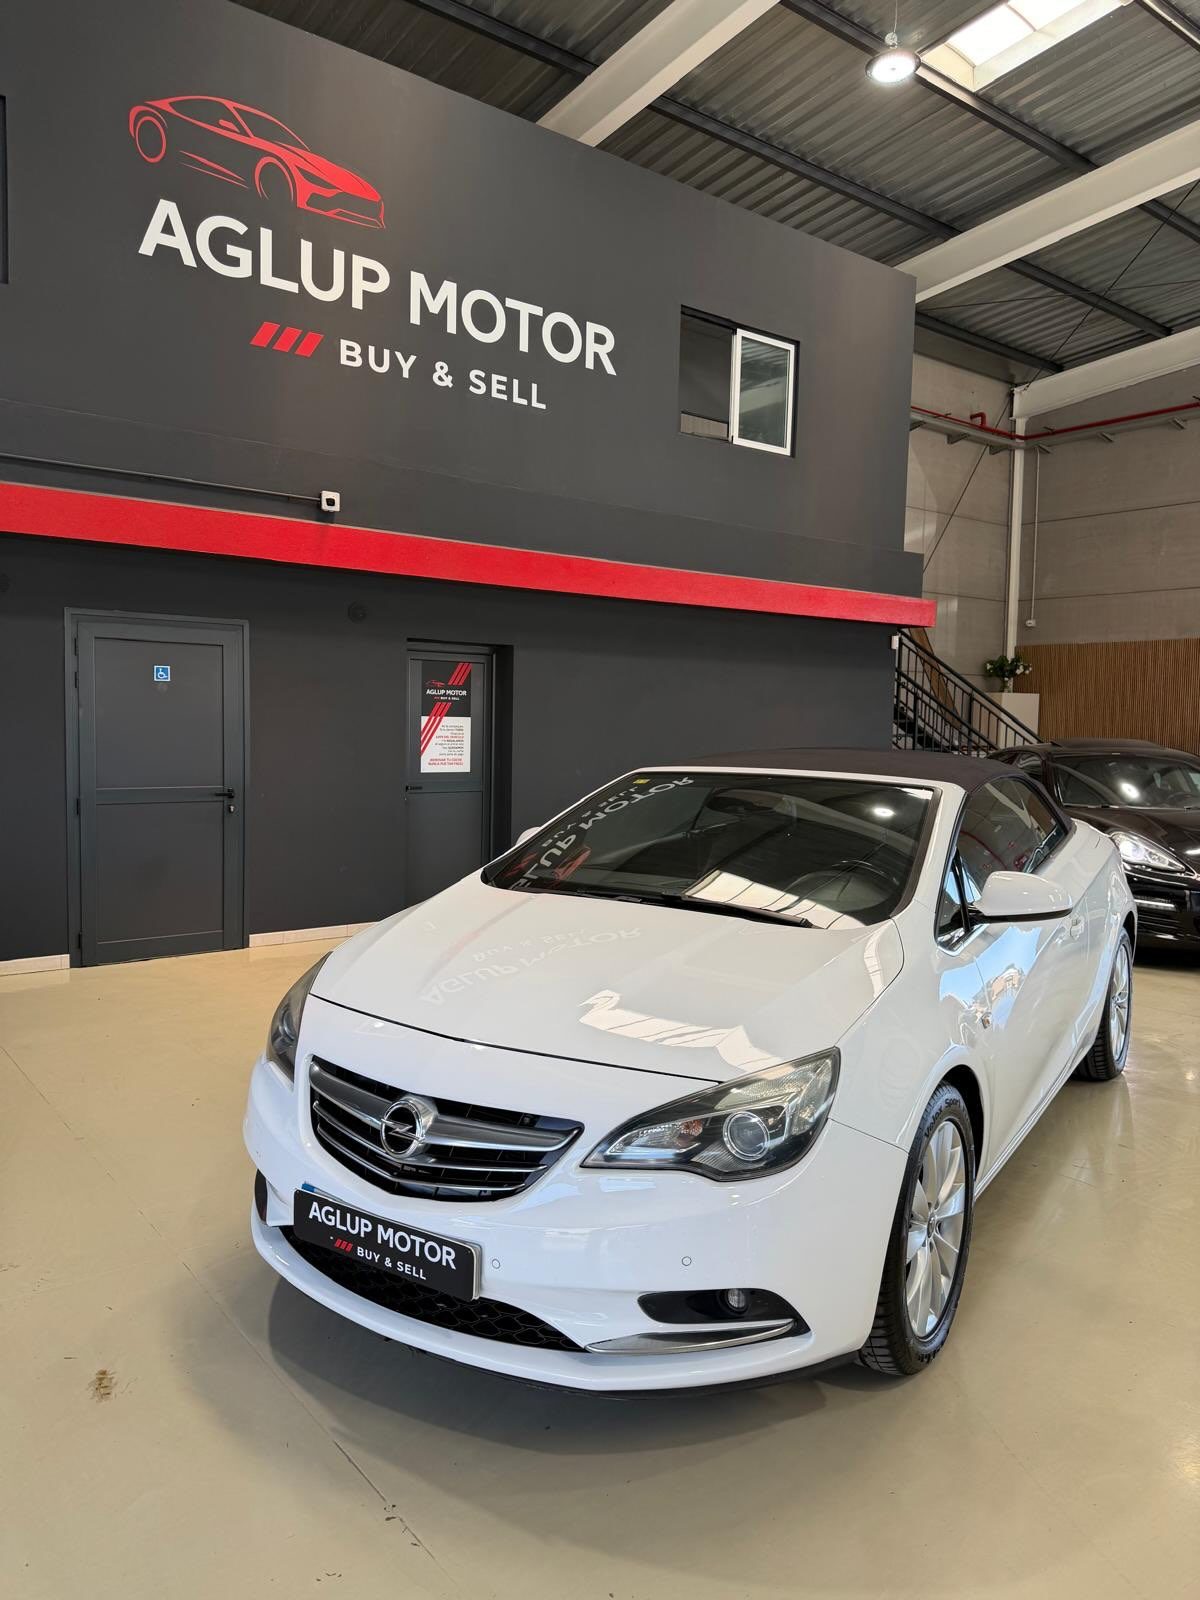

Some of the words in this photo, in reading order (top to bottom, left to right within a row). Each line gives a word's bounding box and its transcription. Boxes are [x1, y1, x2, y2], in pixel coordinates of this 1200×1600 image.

[138, 198, 391, 310] AGLUP
[409, 270, 617, 376] MOTOR
[339, 338, 418, 379] BUY
[432, 360, 454, 388] &
[468, 368, 547, 409] SELL
[426, 688, 446, 696] AGLUP
[446, 689, 467, 697] MOTOR
[308, 1201, 373, 1238] AGLUP
[377, 1224, 457, 1270] MOTOR
[356, 1247, 381, 1263] BUY
[384, 1256, 393, 1268] &
[396, 1261, 427, 1281] SELL
